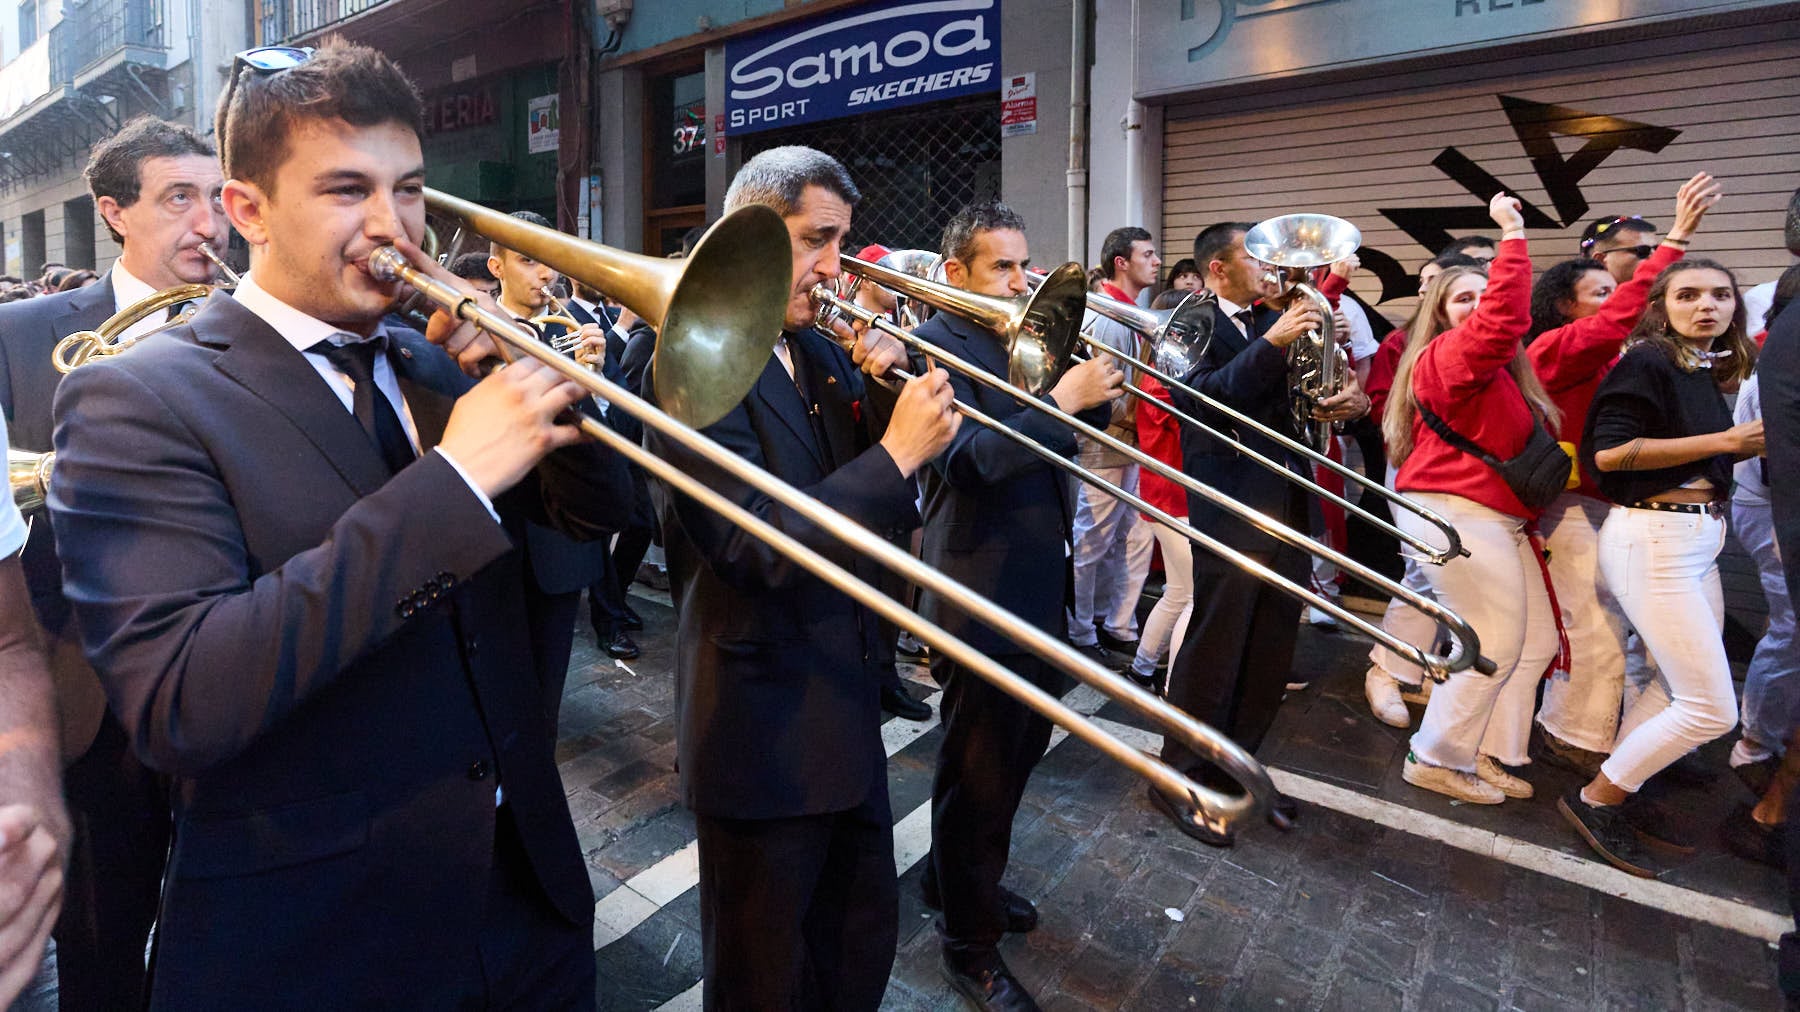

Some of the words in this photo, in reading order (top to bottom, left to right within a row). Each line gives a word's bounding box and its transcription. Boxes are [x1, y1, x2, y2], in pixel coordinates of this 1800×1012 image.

[730, 0, 994, 100] Samoa
[847, 62, 994, 107] SKECHERS
[730, 98, 810, 128] SPORT
[1005, 99, 1034, 109] Alarma
[672, 125, 699, 154] 37
